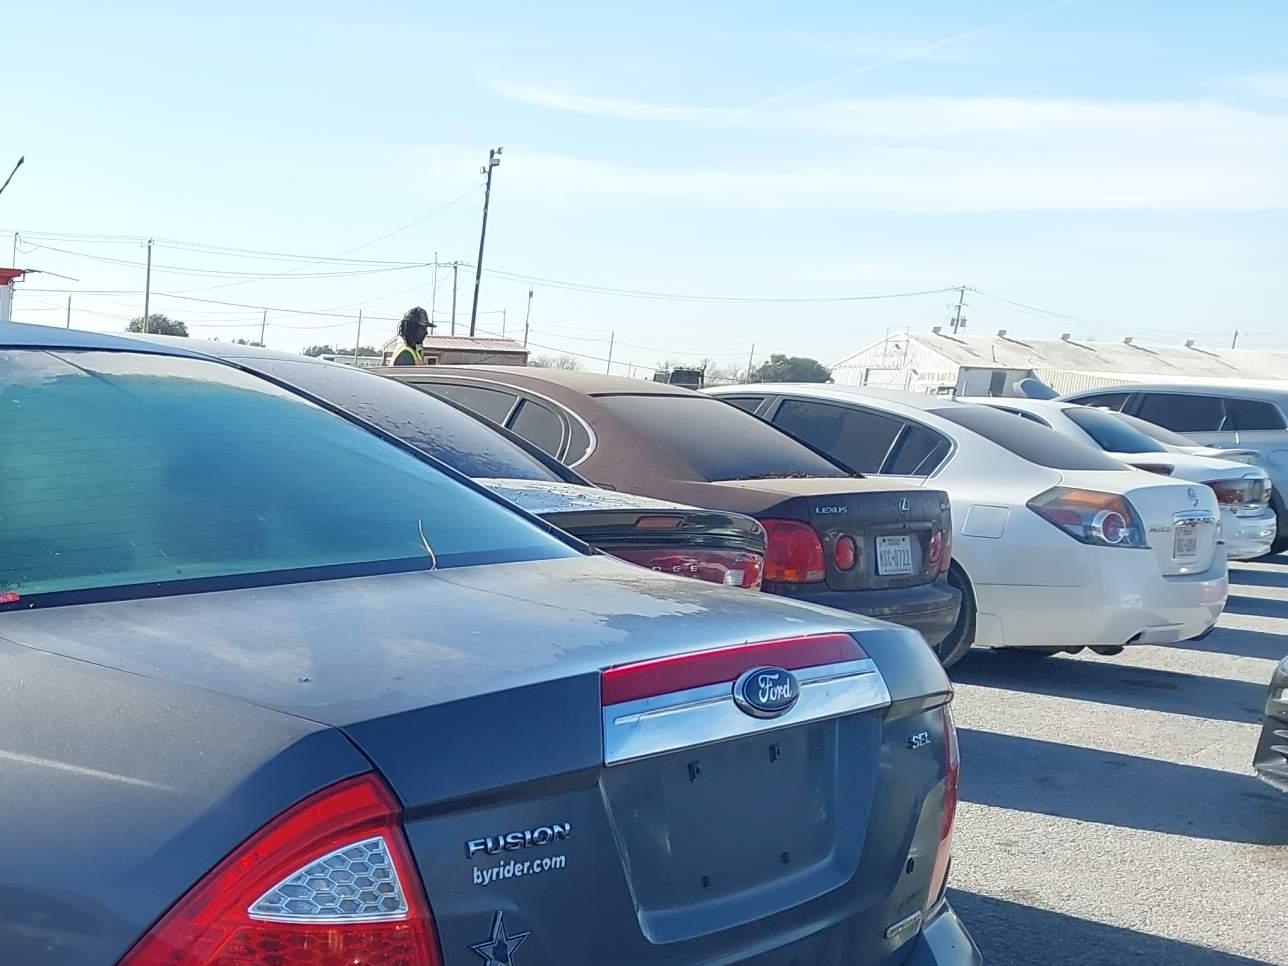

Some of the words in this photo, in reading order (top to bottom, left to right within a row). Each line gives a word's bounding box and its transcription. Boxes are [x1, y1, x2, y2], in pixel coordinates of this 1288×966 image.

[815, 506, 848, 514] LEXUS
[758, 673, 792, 703] Ford
[911, 731, 931, 749] SEL
[467, 822, 571, 858] FUSION
[473, 855, 566, 886] byrider.com
